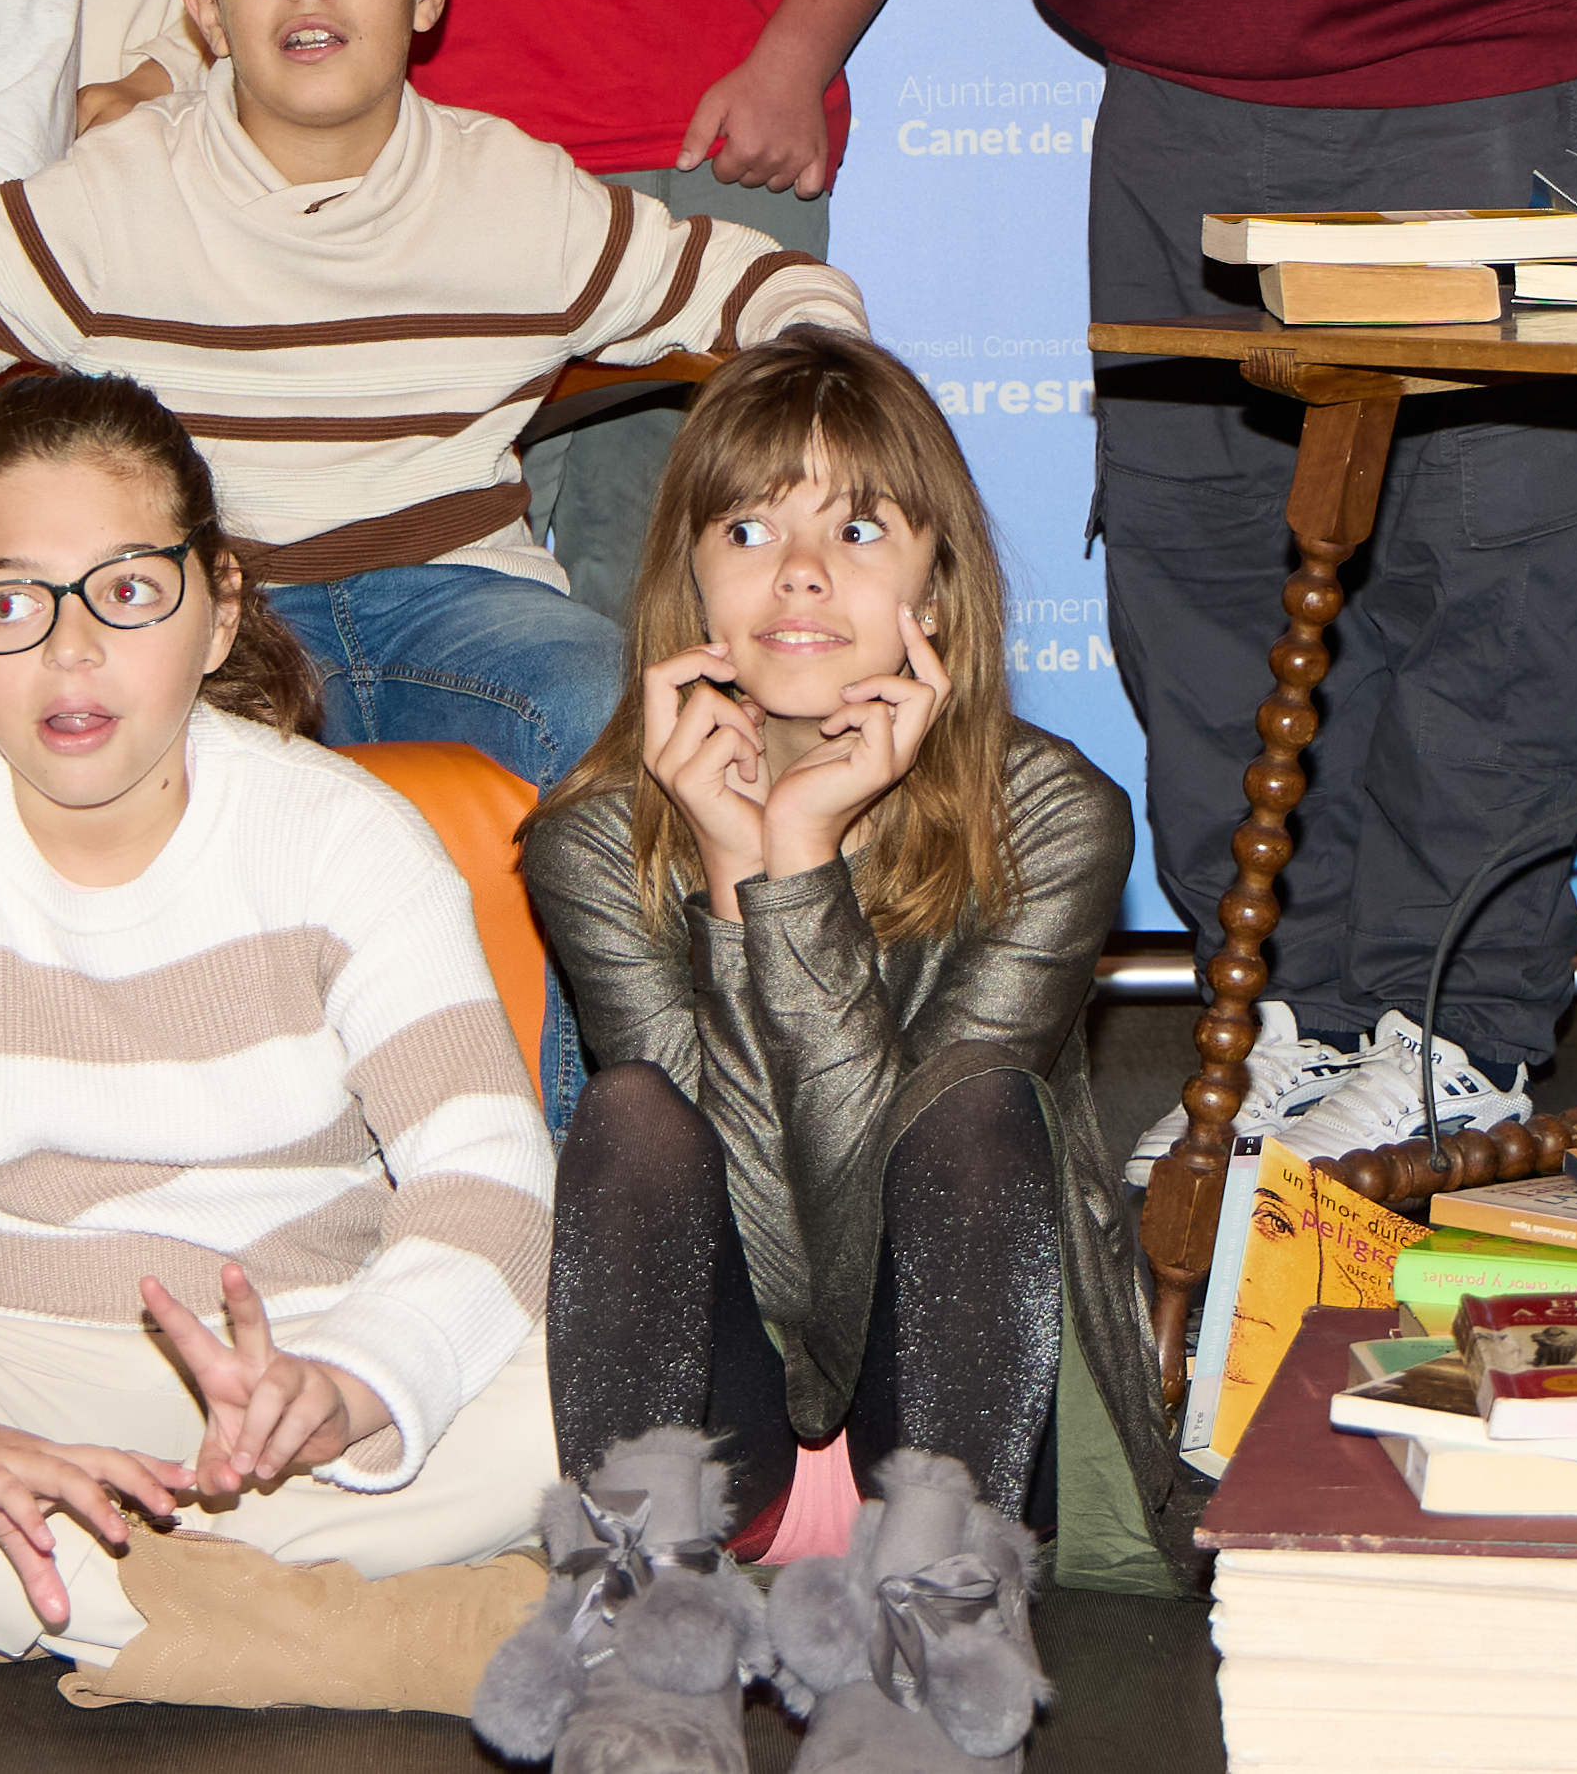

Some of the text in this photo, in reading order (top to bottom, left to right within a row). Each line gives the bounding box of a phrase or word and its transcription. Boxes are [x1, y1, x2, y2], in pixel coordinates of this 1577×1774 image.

[897, 119, 1022, 156] Canet
[1030, 122, 1072, 154] de
[984, 335, 1090, 357] Comarc
[1037, 639, 1080, 672] de
[1282, 1167, 1410, 1248] un amor dulc
[1221, 1254, 1233, 1281] amor
[1346, 1262, 1382, 1287] nicci
[1422, 1272, 1486, 1289] pañales
[1492, 1274, 1500, 1288] y
[1510, 1279, 1548, 1293] amor
[1216, 1284, 1229, 1311] dulce
[1512, 1308, 1536, 1317] A
[1203, 1325, 1221, 1374] peligroso
